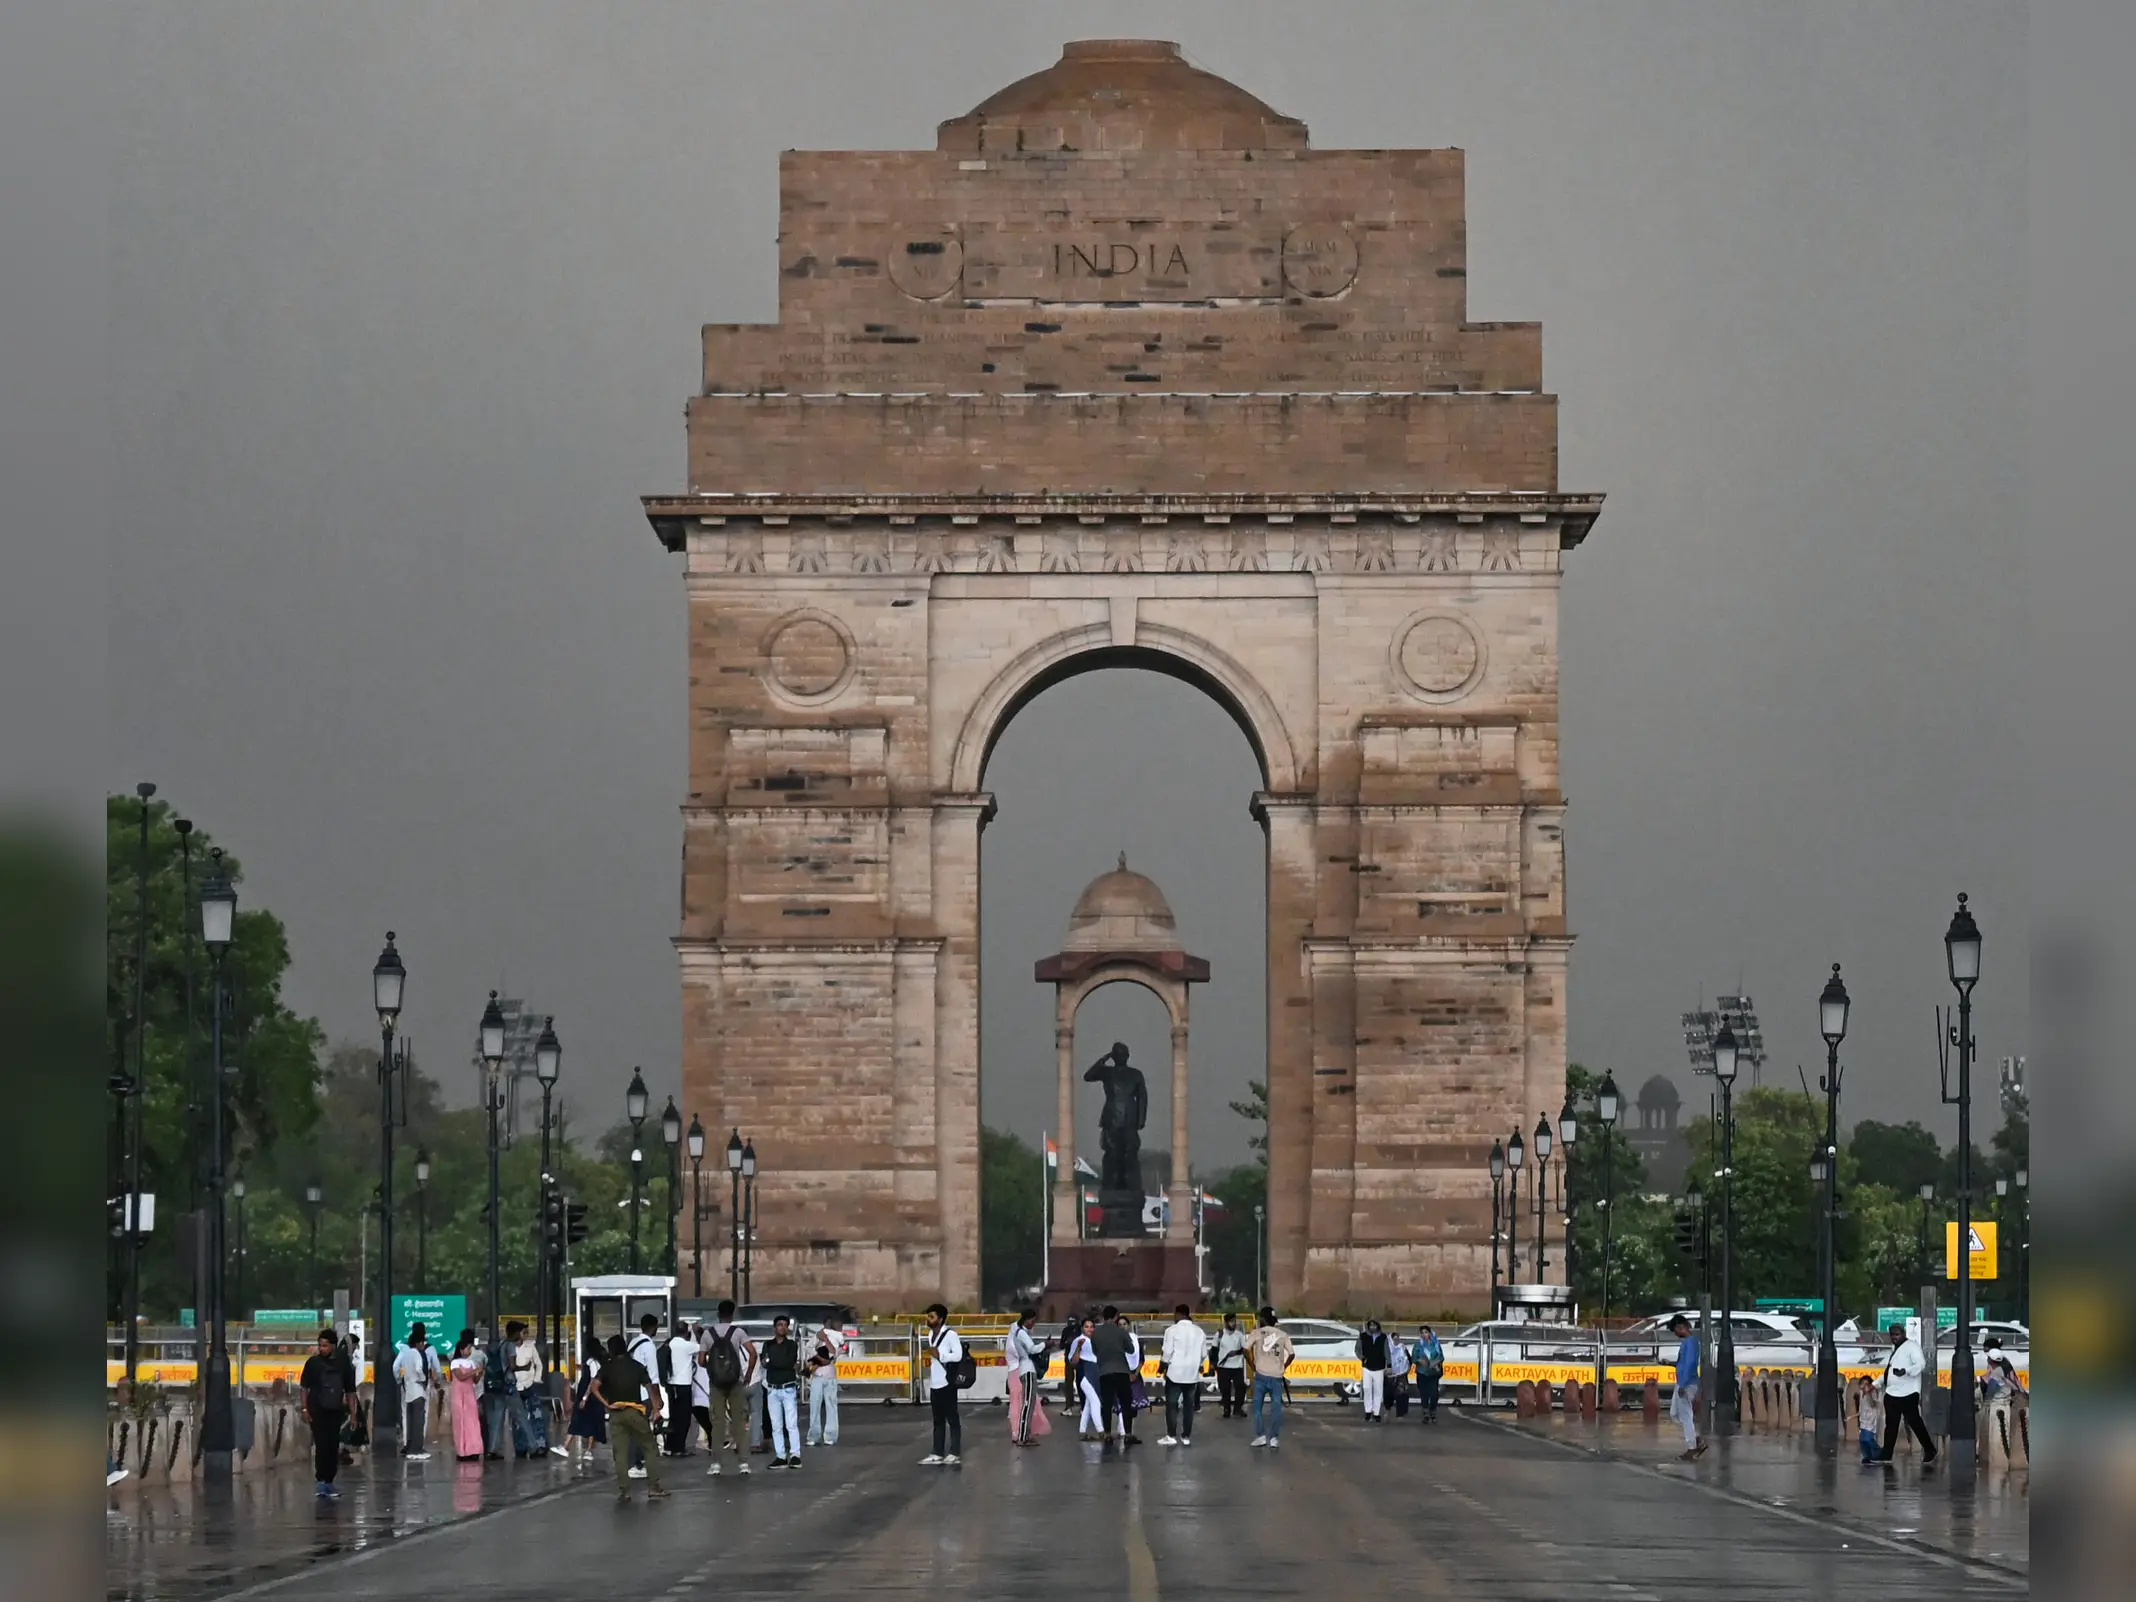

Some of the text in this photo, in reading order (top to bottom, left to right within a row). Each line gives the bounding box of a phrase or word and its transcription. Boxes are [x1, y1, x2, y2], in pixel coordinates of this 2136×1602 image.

[1054, 244, 1190, 275] INDIA
[838, 1364, 905, 1376] TAVYA PATH
[1289, 1364, 1357, 1376] TAVYA PATH
[1444, 1365, 1473, 1377] PATH
[1496, 1367, 1590, 1381] KARTAVYA PATH
